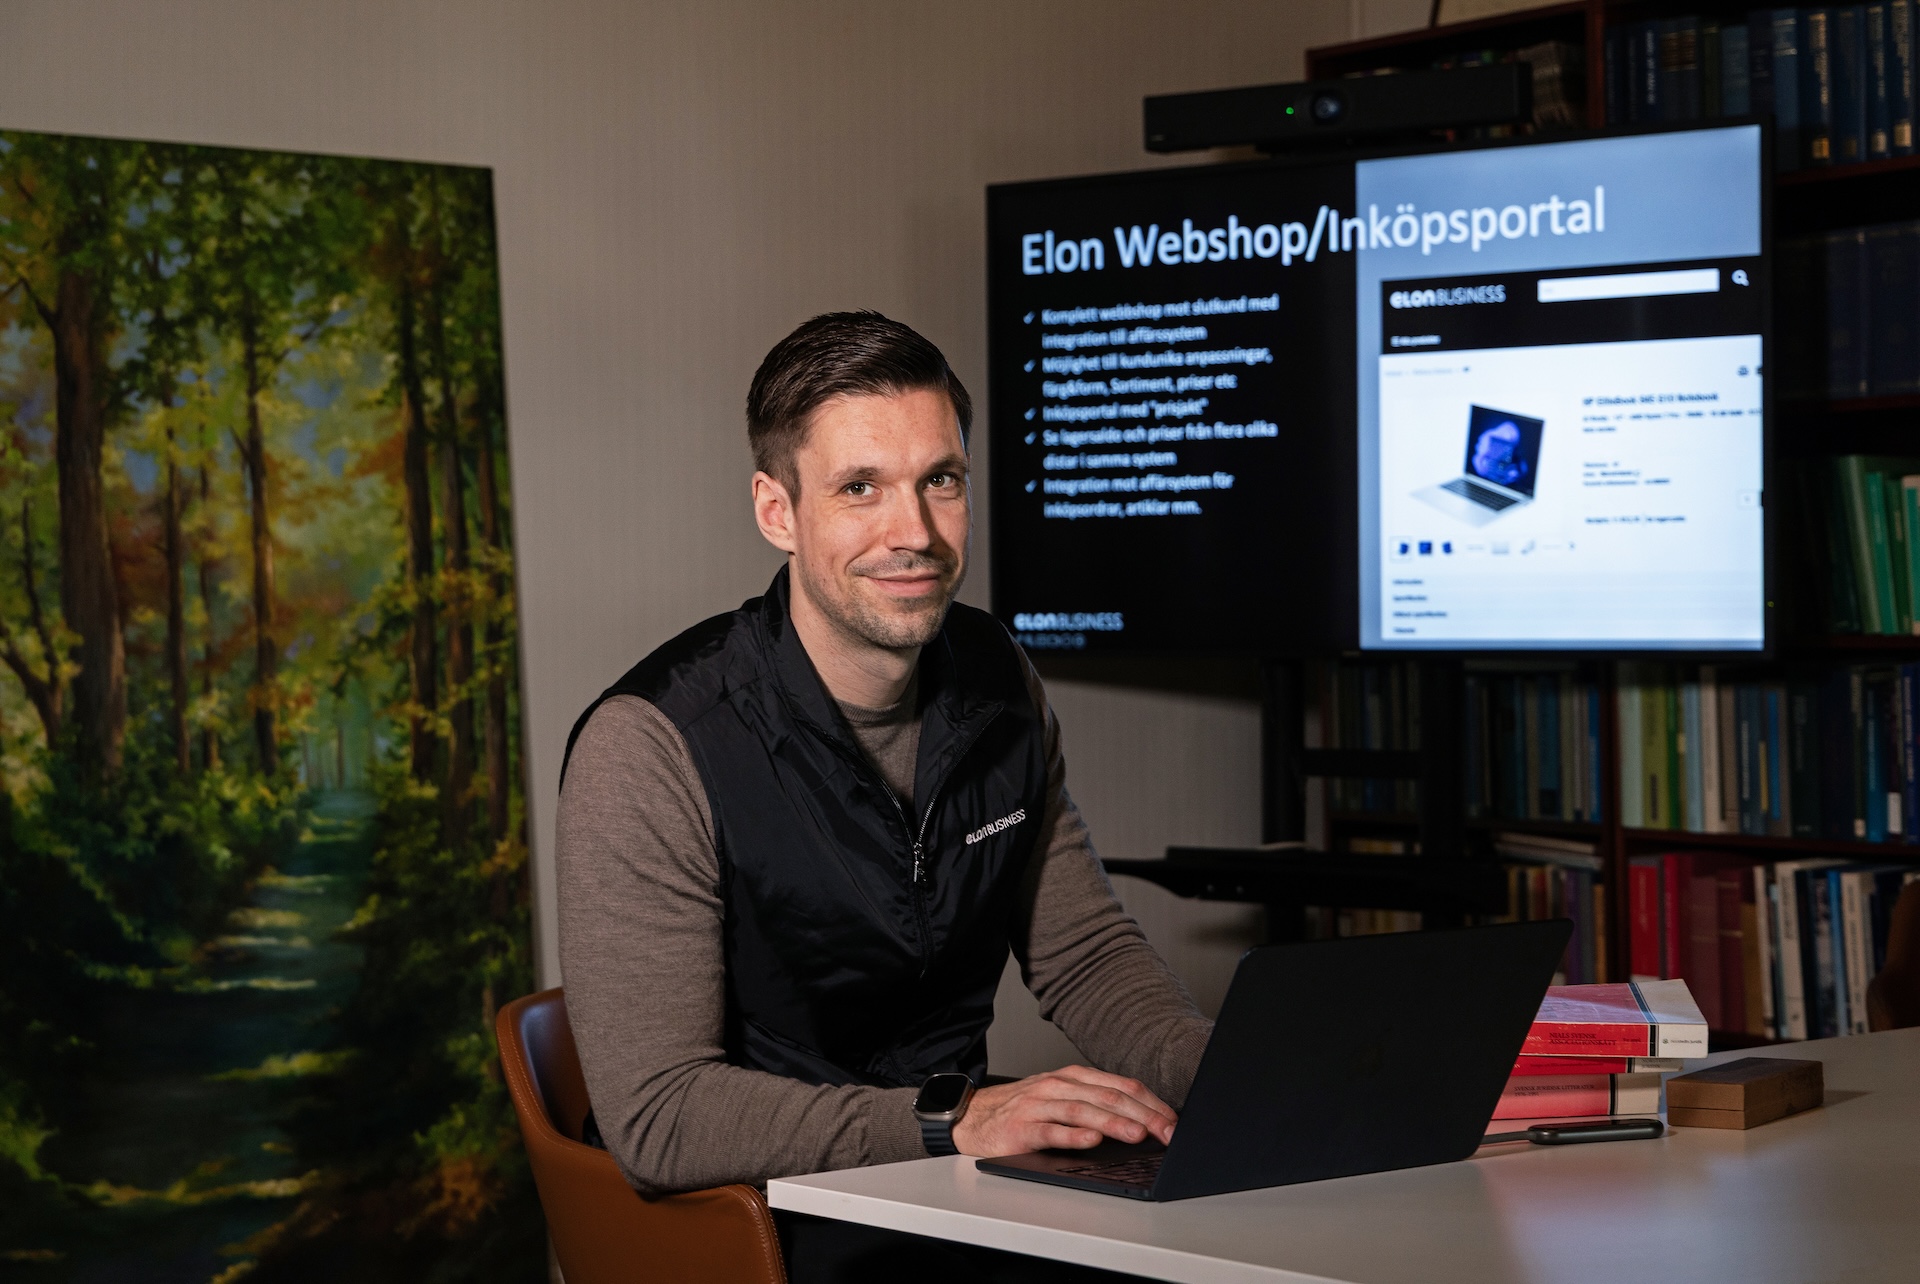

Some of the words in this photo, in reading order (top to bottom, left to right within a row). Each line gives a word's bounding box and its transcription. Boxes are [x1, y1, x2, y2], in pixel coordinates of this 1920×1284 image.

[1021, 230, 1105, 276] Elon
[1113, 185, 1606, 266] Webshop/Inköpsportal
[1042, 306, 1099, 326] Komplett
[1100, 302, 1163, 321] webbshop
[1163, 300, 1192, 317] mot
[1192, 297, 1247, 316] slutkund
[1248, 293, 1280, 312] med
[1042, 331, 1109, 351] integration
[1109, 327, 1128, 346] till
[1042, 355, 1101, 376] Möjlighet
[1101, 352, 1120, 371] till
[1120, 350, 1184, 370] kundunika
[1176, 374, 1214, 395] priser
[1215, 372, 1238, 390] etc
[1042, 401, 1119, 423] Inköpsportal
[1119, 400, 1149, 420] med
[1043, 428, 1060, 446] Se
[1060, 426, 1123, 448] lagersaldo
[1123, 424, 1148, 443] och
[1148, 424, 1184, 445] priser
[1185, 421, 1214, 441] från
[1214, 420, 1245, 440] flera
[1245, 418, 1279, 438] olika
[1086, 452, 1131, 469] samma
[1131, 450, 1178, 470] system
[1044, 477, 1111, 497] Integration
[1111, 475, 1139, 494] mot
[1213, 470, 1236, 490] för
[1125, 498, 1171, 517] artiklar
